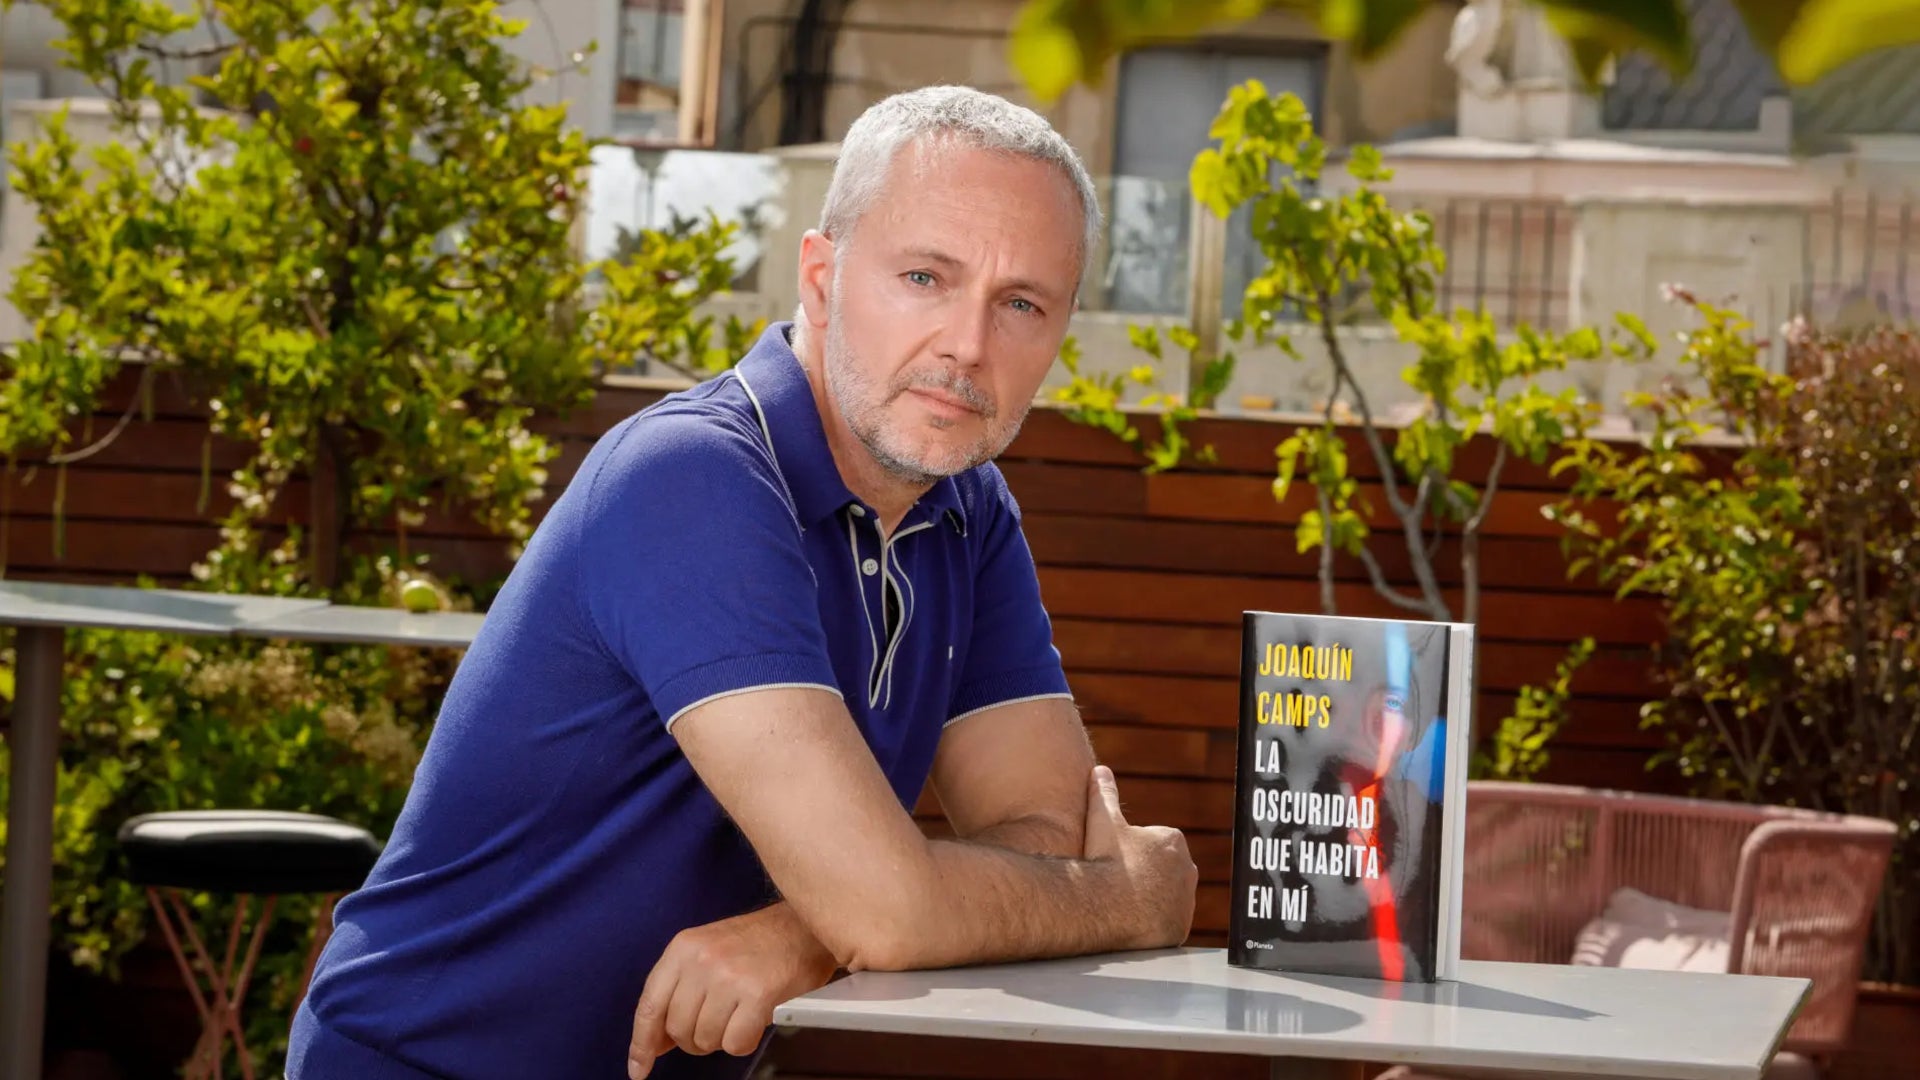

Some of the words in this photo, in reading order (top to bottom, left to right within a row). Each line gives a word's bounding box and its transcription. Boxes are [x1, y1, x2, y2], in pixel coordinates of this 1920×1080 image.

[1259, 643, 1353, 682] JOAQUÍN
[1257, 691, 1331, 729] CAMPS
[1254, 739, 1280, 774] LA
[1252, 788, 1375, 830] OSCURIDAD
[1250, 836, 1291, 874] QUE
[1299, 841, 1379, 880] HABITA
[1248, 885, 1273, 920] EN
[1281, 885, 1309, 922] MÍ
[1253, 941, 1274, 950] Planeta
